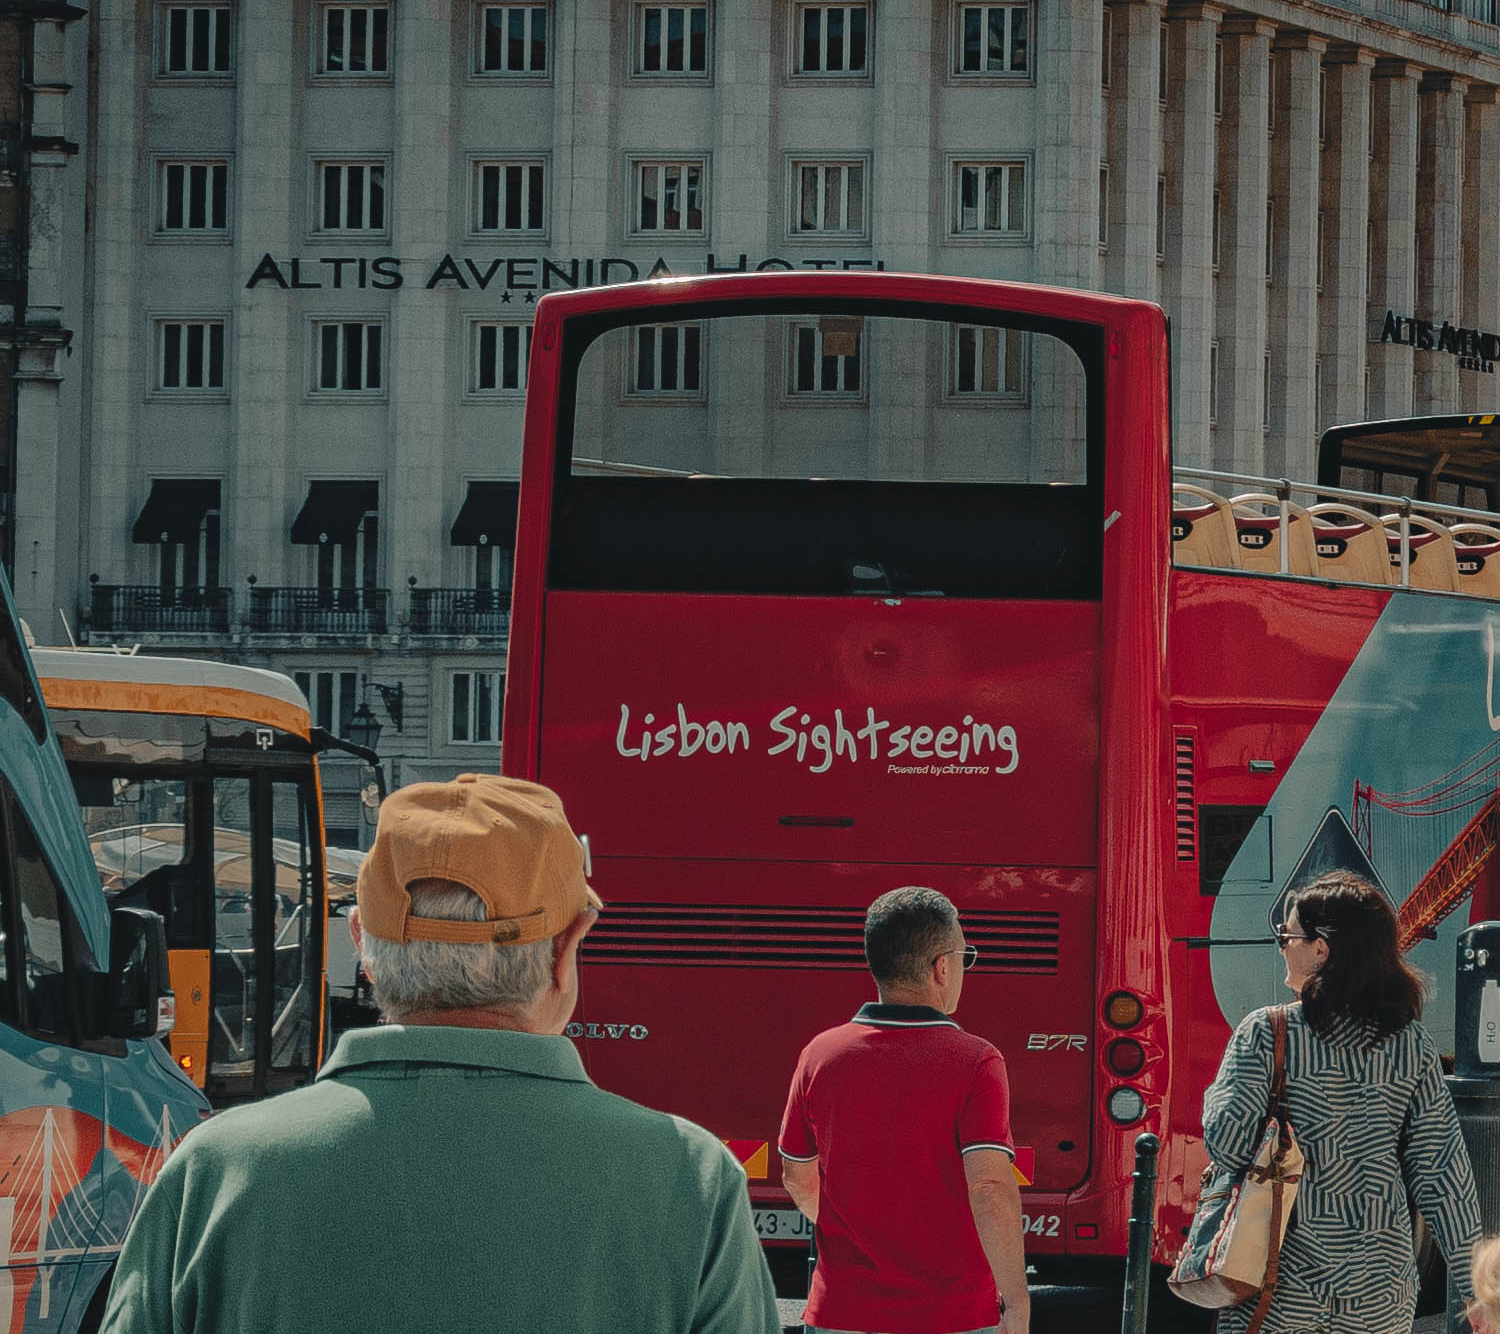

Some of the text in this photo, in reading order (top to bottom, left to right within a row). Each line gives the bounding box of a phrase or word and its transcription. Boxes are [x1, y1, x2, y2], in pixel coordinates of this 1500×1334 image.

[245, 252, 404, 290] ALTIS
[425, 252, 676, 290] AVENIDA
[1381, 310, 1433, 351] ALTIS
[616, 702, 1020, 774] Lisbon Sightseeing
[566, 1022, 649, 1040] OLVO
[1026, 1033, 1088, 1052] B7R
